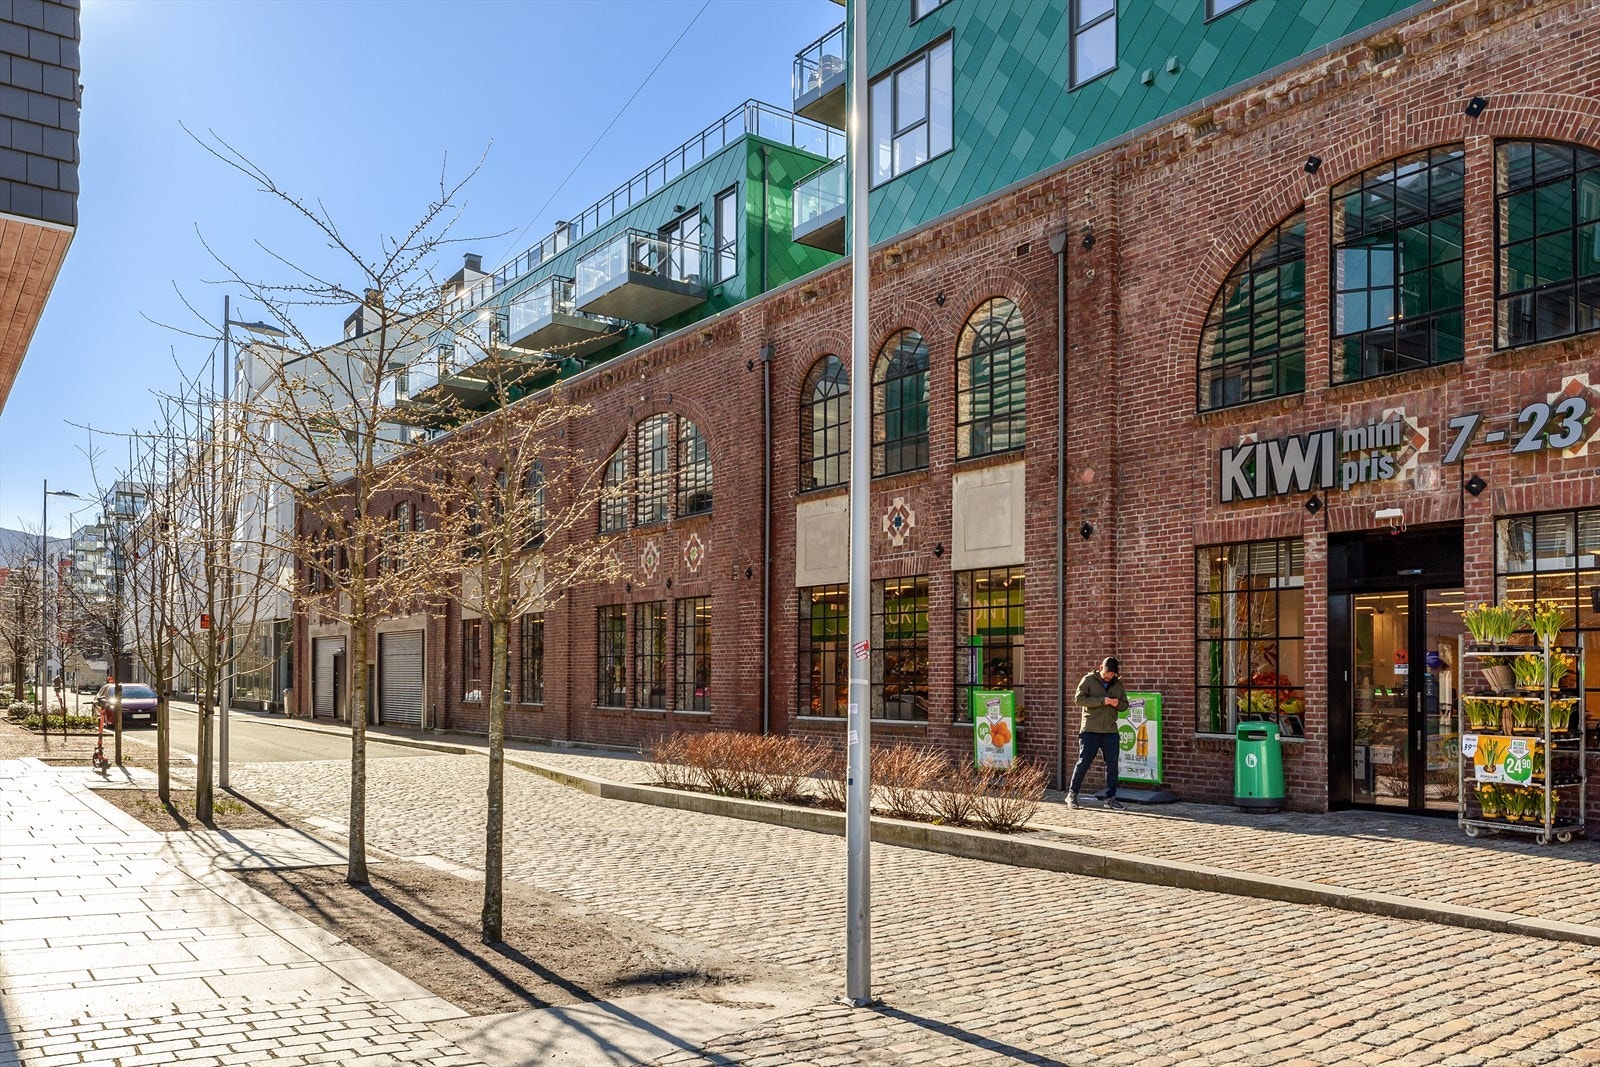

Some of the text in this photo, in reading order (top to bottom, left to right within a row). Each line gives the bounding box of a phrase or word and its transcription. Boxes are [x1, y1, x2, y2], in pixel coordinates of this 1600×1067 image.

[1343, 418, 1399, 453] mini
[1442, 413, 1481, 465] 7
[1511, 396, 1588, 454] 23
[1220, 428, 1336, 503] KIWI
[1343, 449, 1396, 491] pris
